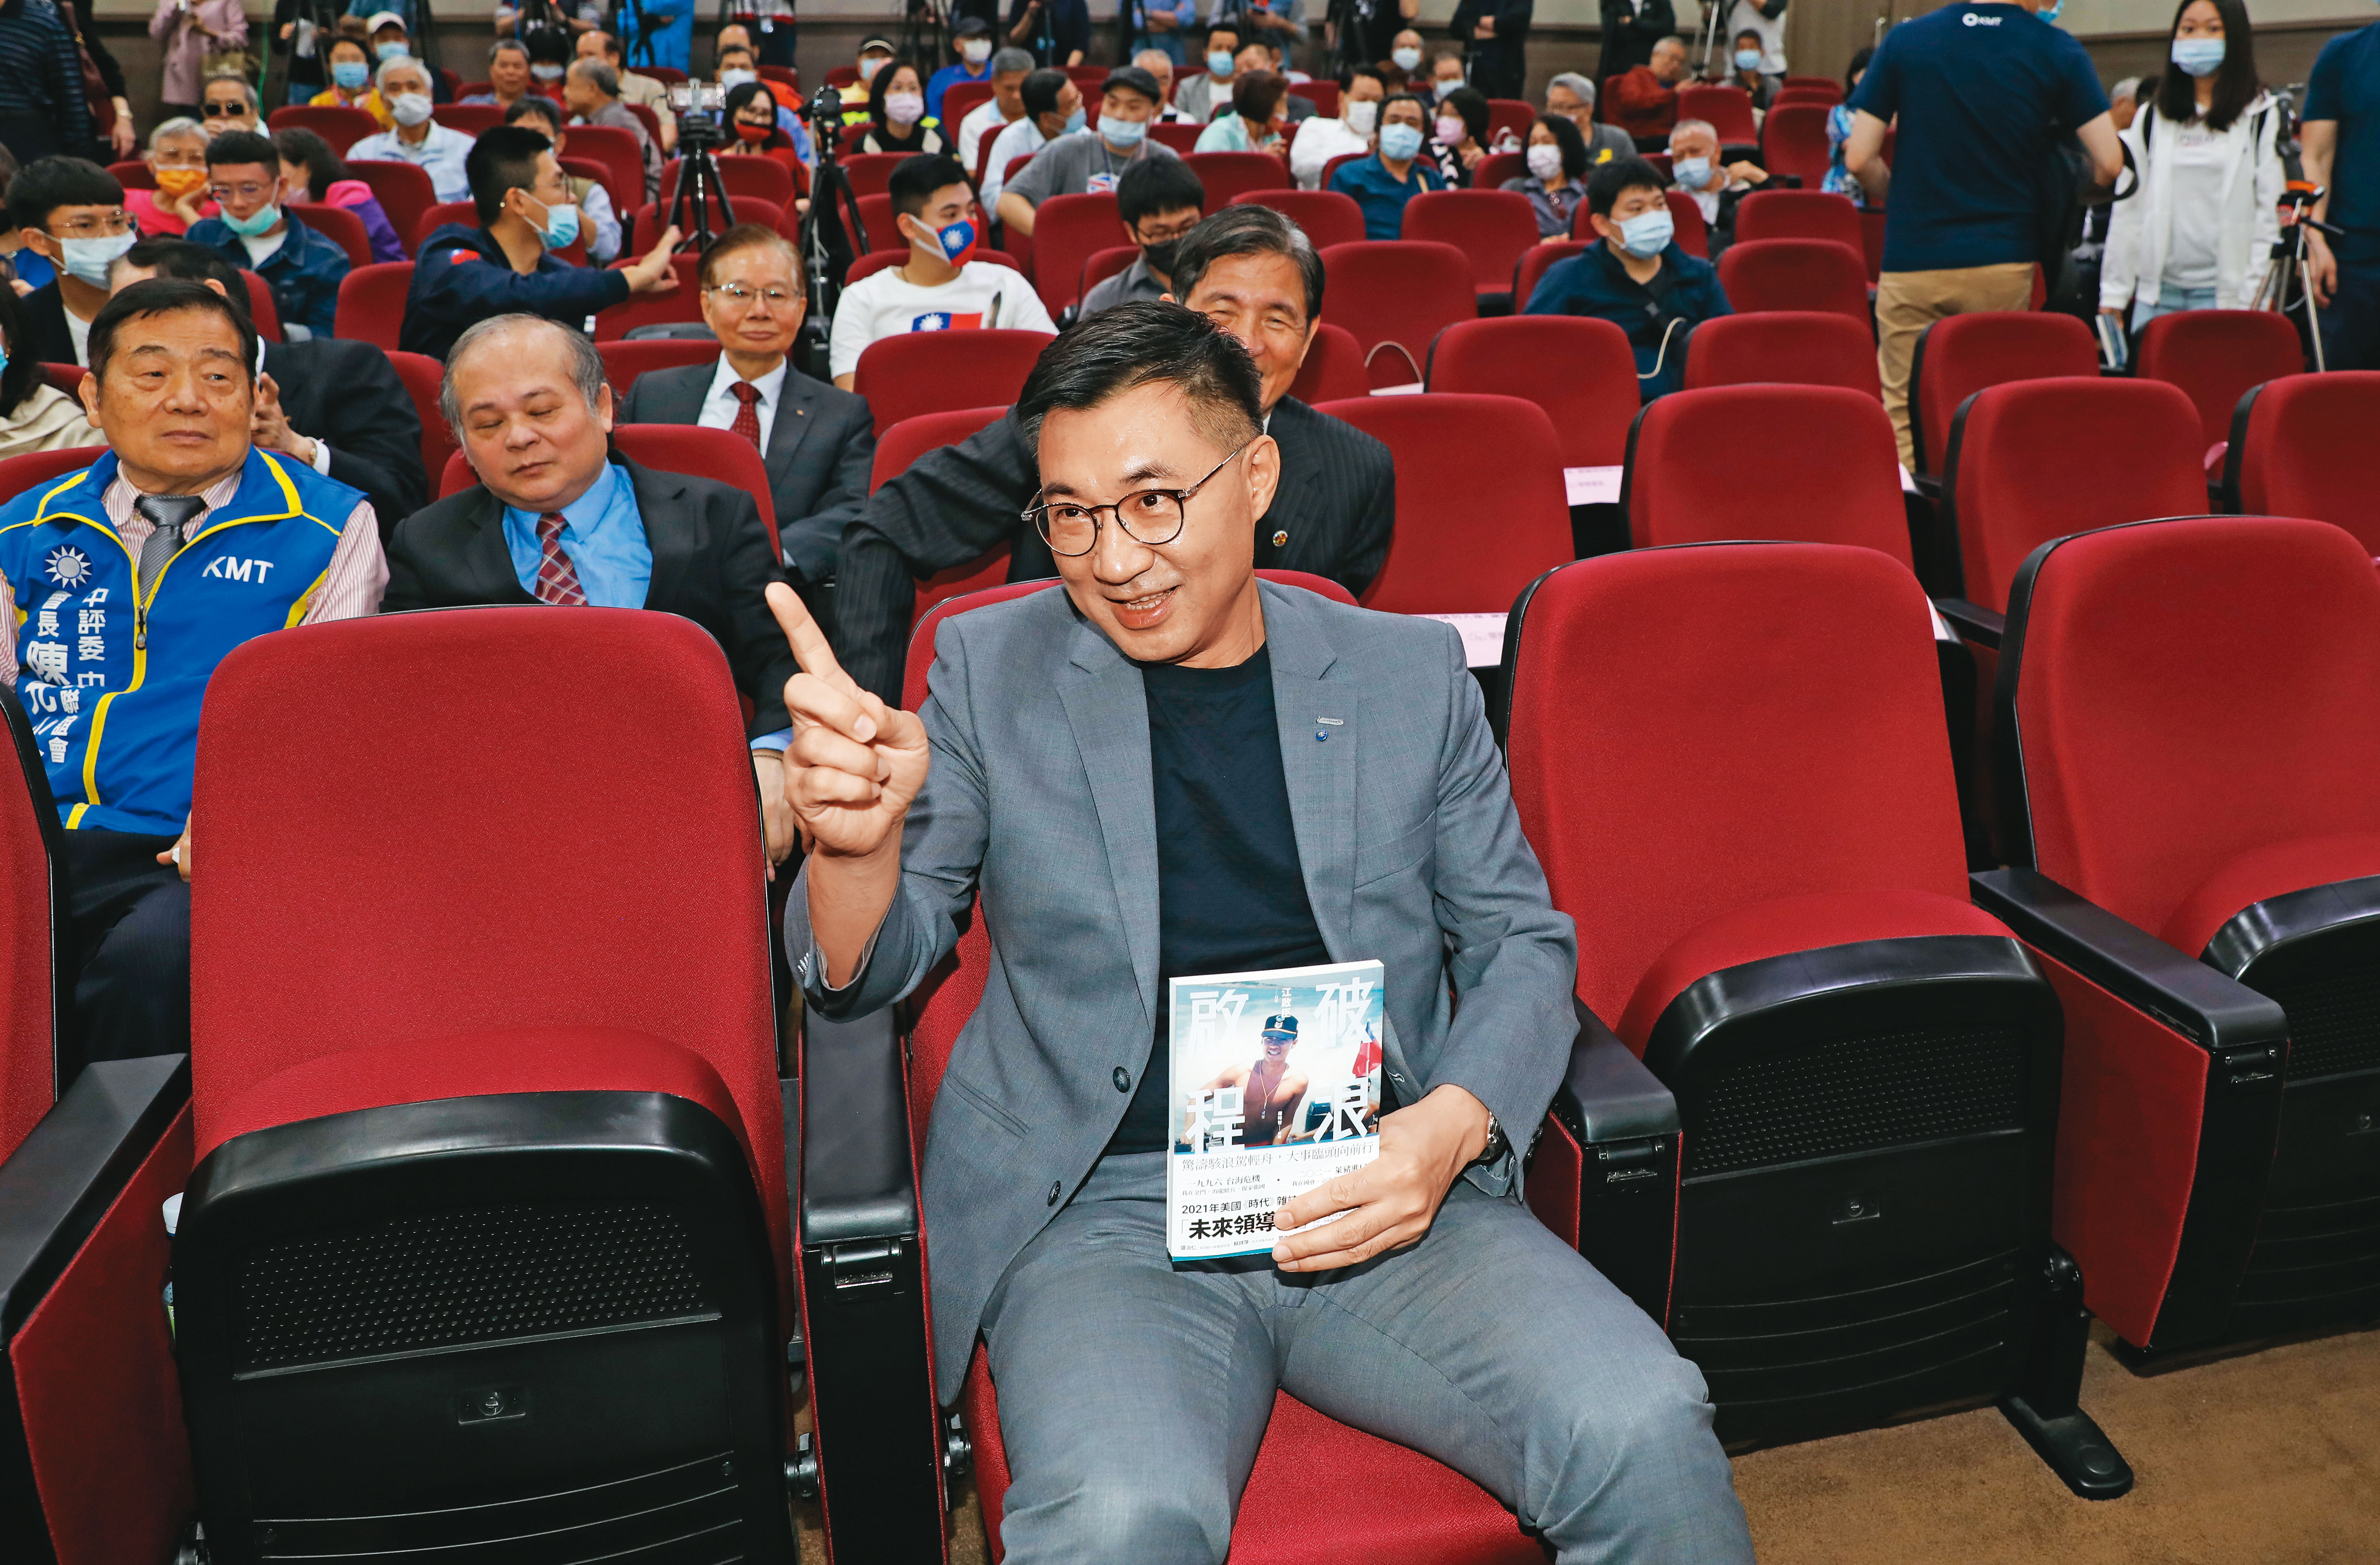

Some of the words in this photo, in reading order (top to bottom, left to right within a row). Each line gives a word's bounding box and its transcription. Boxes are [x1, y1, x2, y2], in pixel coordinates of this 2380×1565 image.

[202, 556, 274, 584] KMT
[37, 590, 73, 637] 會長
[78, 587, 109, 661] 中評委
[1186, 989, 1249, 1154] 啟程
[1313, 977, 1375, 1144] 破浪
[1187, 1179, 1222, 1187] 一九九六
[1226, 1174, 1260, 1186] 台海危機
[1181, 1211, 1306, 1239] 「未來領導」
